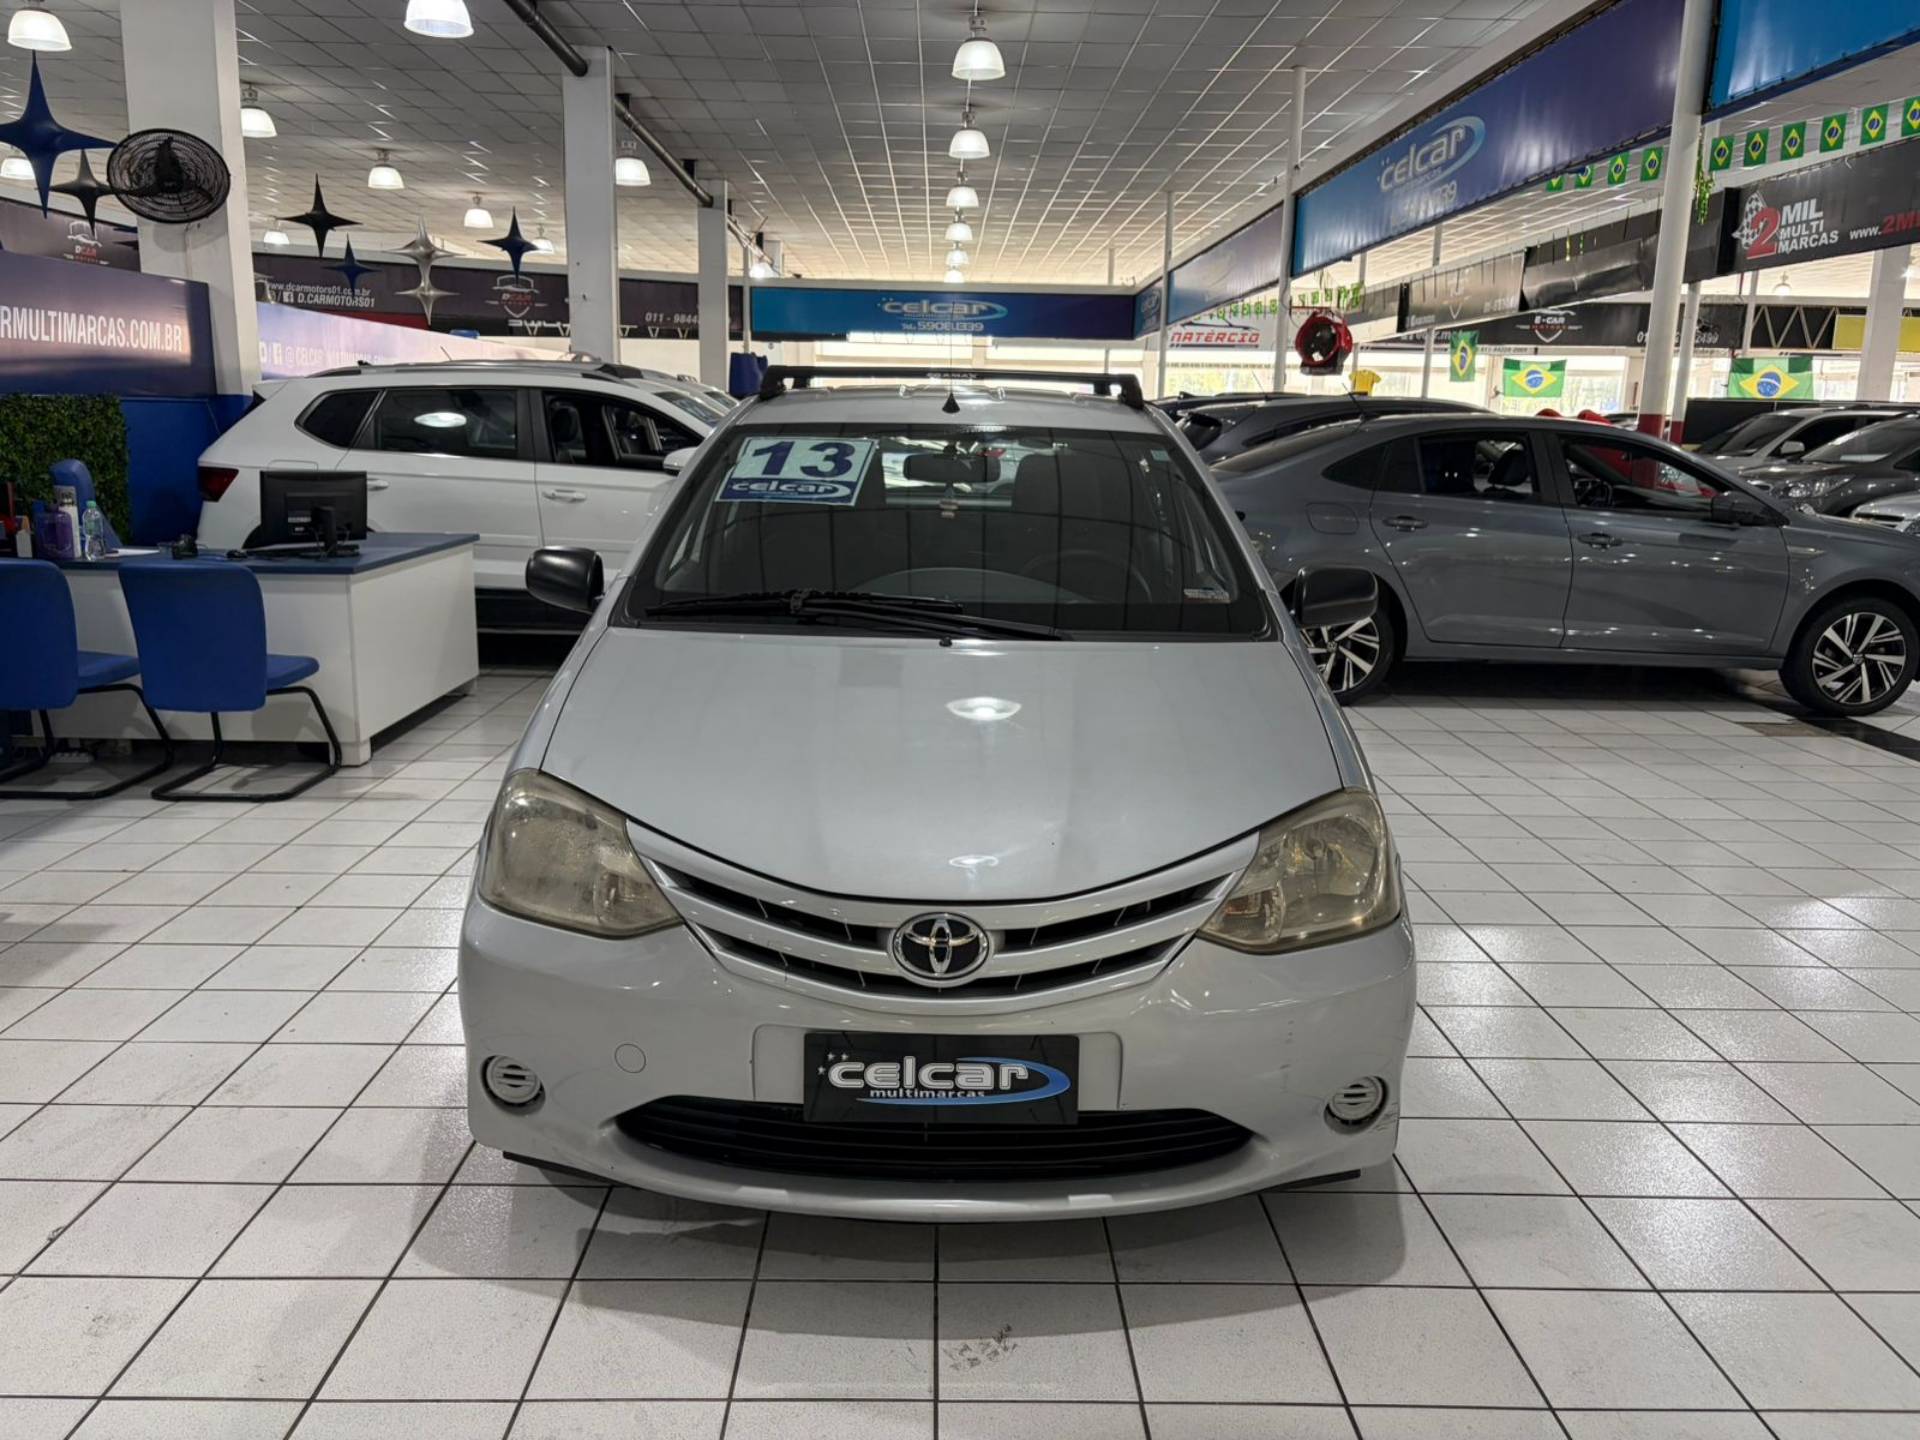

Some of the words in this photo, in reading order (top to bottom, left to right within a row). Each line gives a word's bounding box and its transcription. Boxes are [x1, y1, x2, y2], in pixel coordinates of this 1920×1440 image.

[1380, 127, 1466, 192] celcar
[1746, 207, 1781, 259] 2
[1781, 198, 1824, 226] MIL
[1779, 219, 1825, 241] MULTI
[1849, 210, 1920, 240] www.2M
[1778, 231, 1839, 255] MARCAS
[297, 292, 375, 308] D.CARMOTORS01
[884, 299, 988, 315] celcar
[752, 440, 856, 478] 13
[732, 480, 834, 495] celcar
[828, 1055, 1029, 1090] celcar
[869, 1087, 986, 1099] multimarcas
